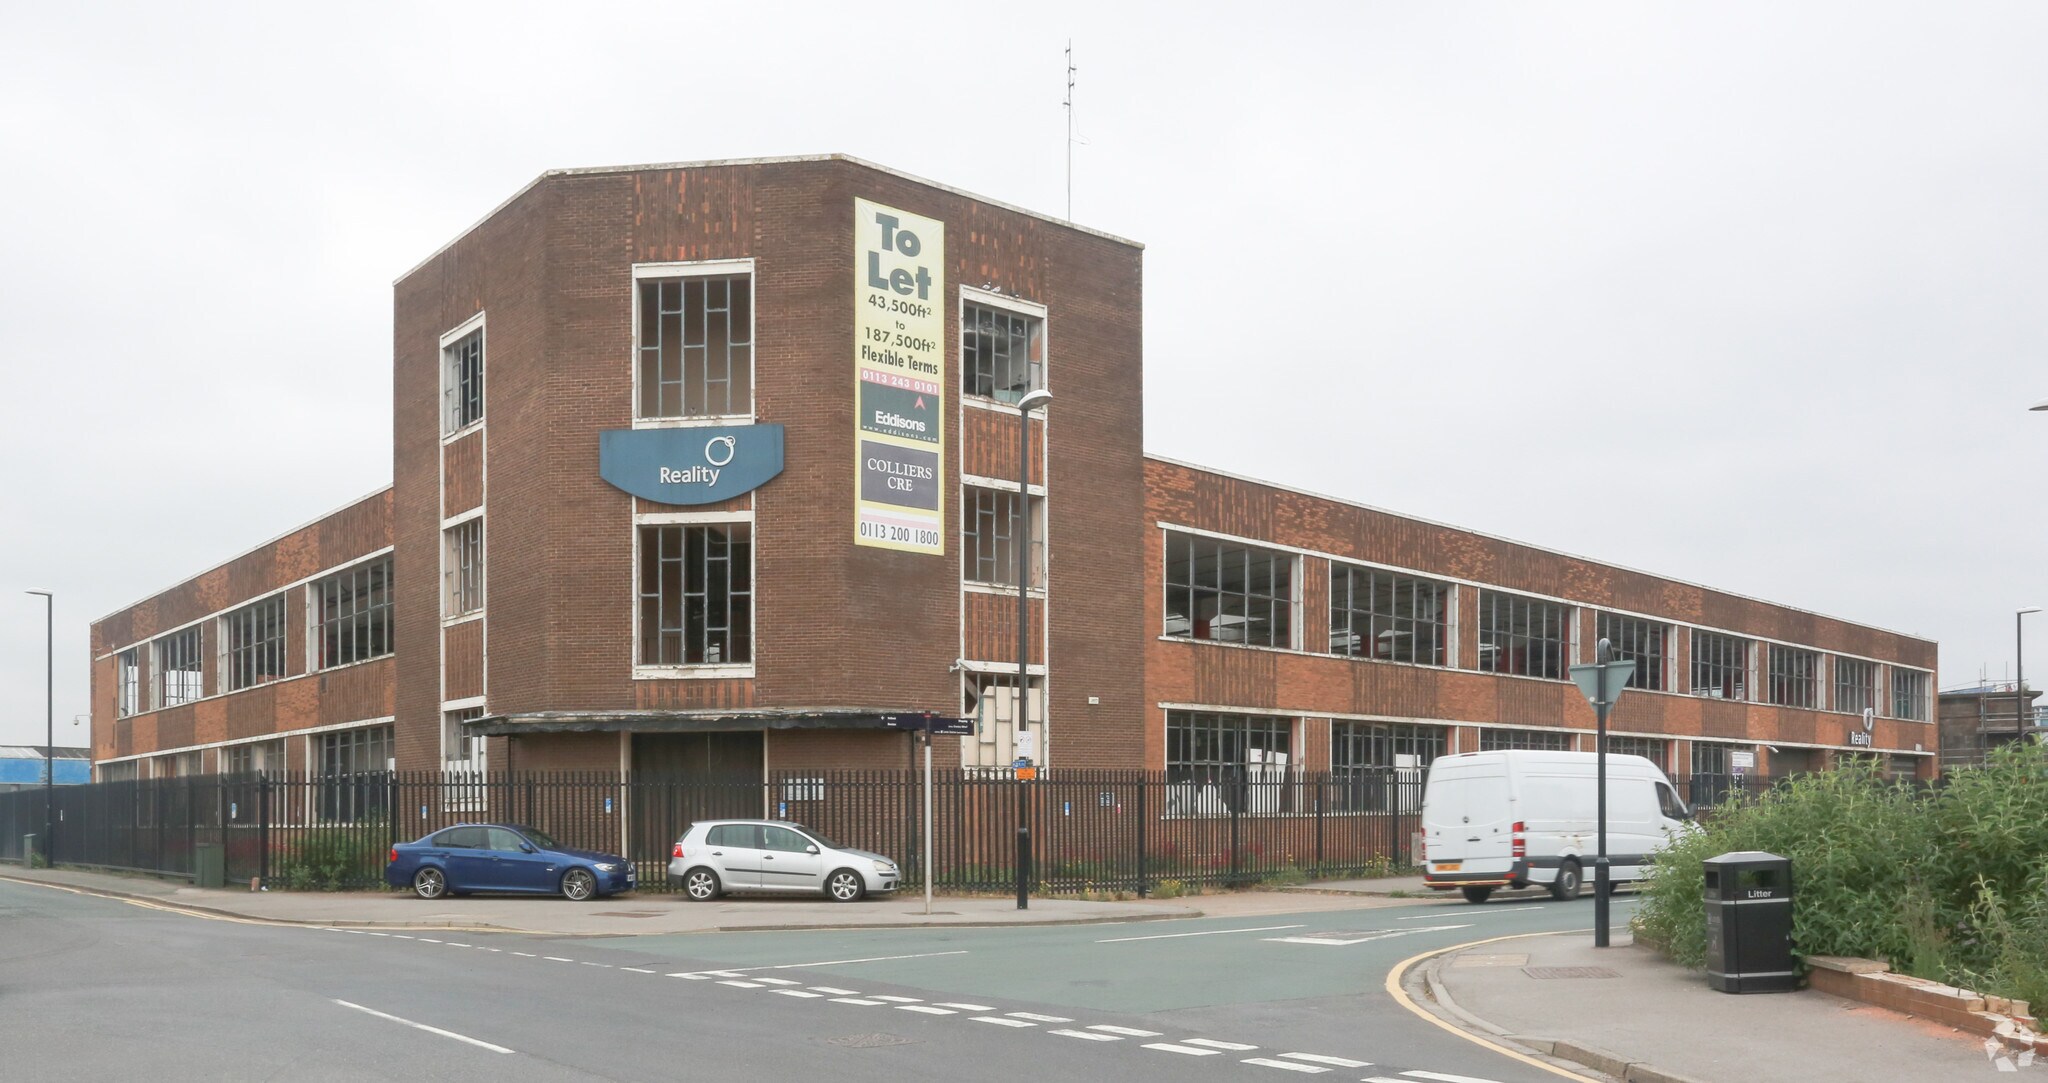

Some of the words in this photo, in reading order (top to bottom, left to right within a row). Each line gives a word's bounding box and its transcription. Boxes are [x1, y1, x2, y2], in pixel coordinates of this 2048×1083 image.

[876, 212, 921, 257] To
[868, 250, 931, 300] Let
[895, 320, 906, 331] to
[861, 344, 904, 368] Flexible
[907, 355, 938, 375] Terms
[862, 370, 888, 383] 0113
[892, 376, 910, 388] 243
[915, 382, 938, 394] 0101
[875, 410, 925, 432] Eddisons
[862, 425, 938, 442] www.eddisons.com
[660, 466, 720, 487] Reality
[867, 457, 933, 479] COLLIERS
[887, 476, 914, 491] CRE
[860, 521, 886, 539] 0113
[890, 526, 909, 542] 200
[915, 529, 938, 546] 1800
[1851, 731, 1872, 749] Reality
[1747, 889, 1772, 899] Litter
